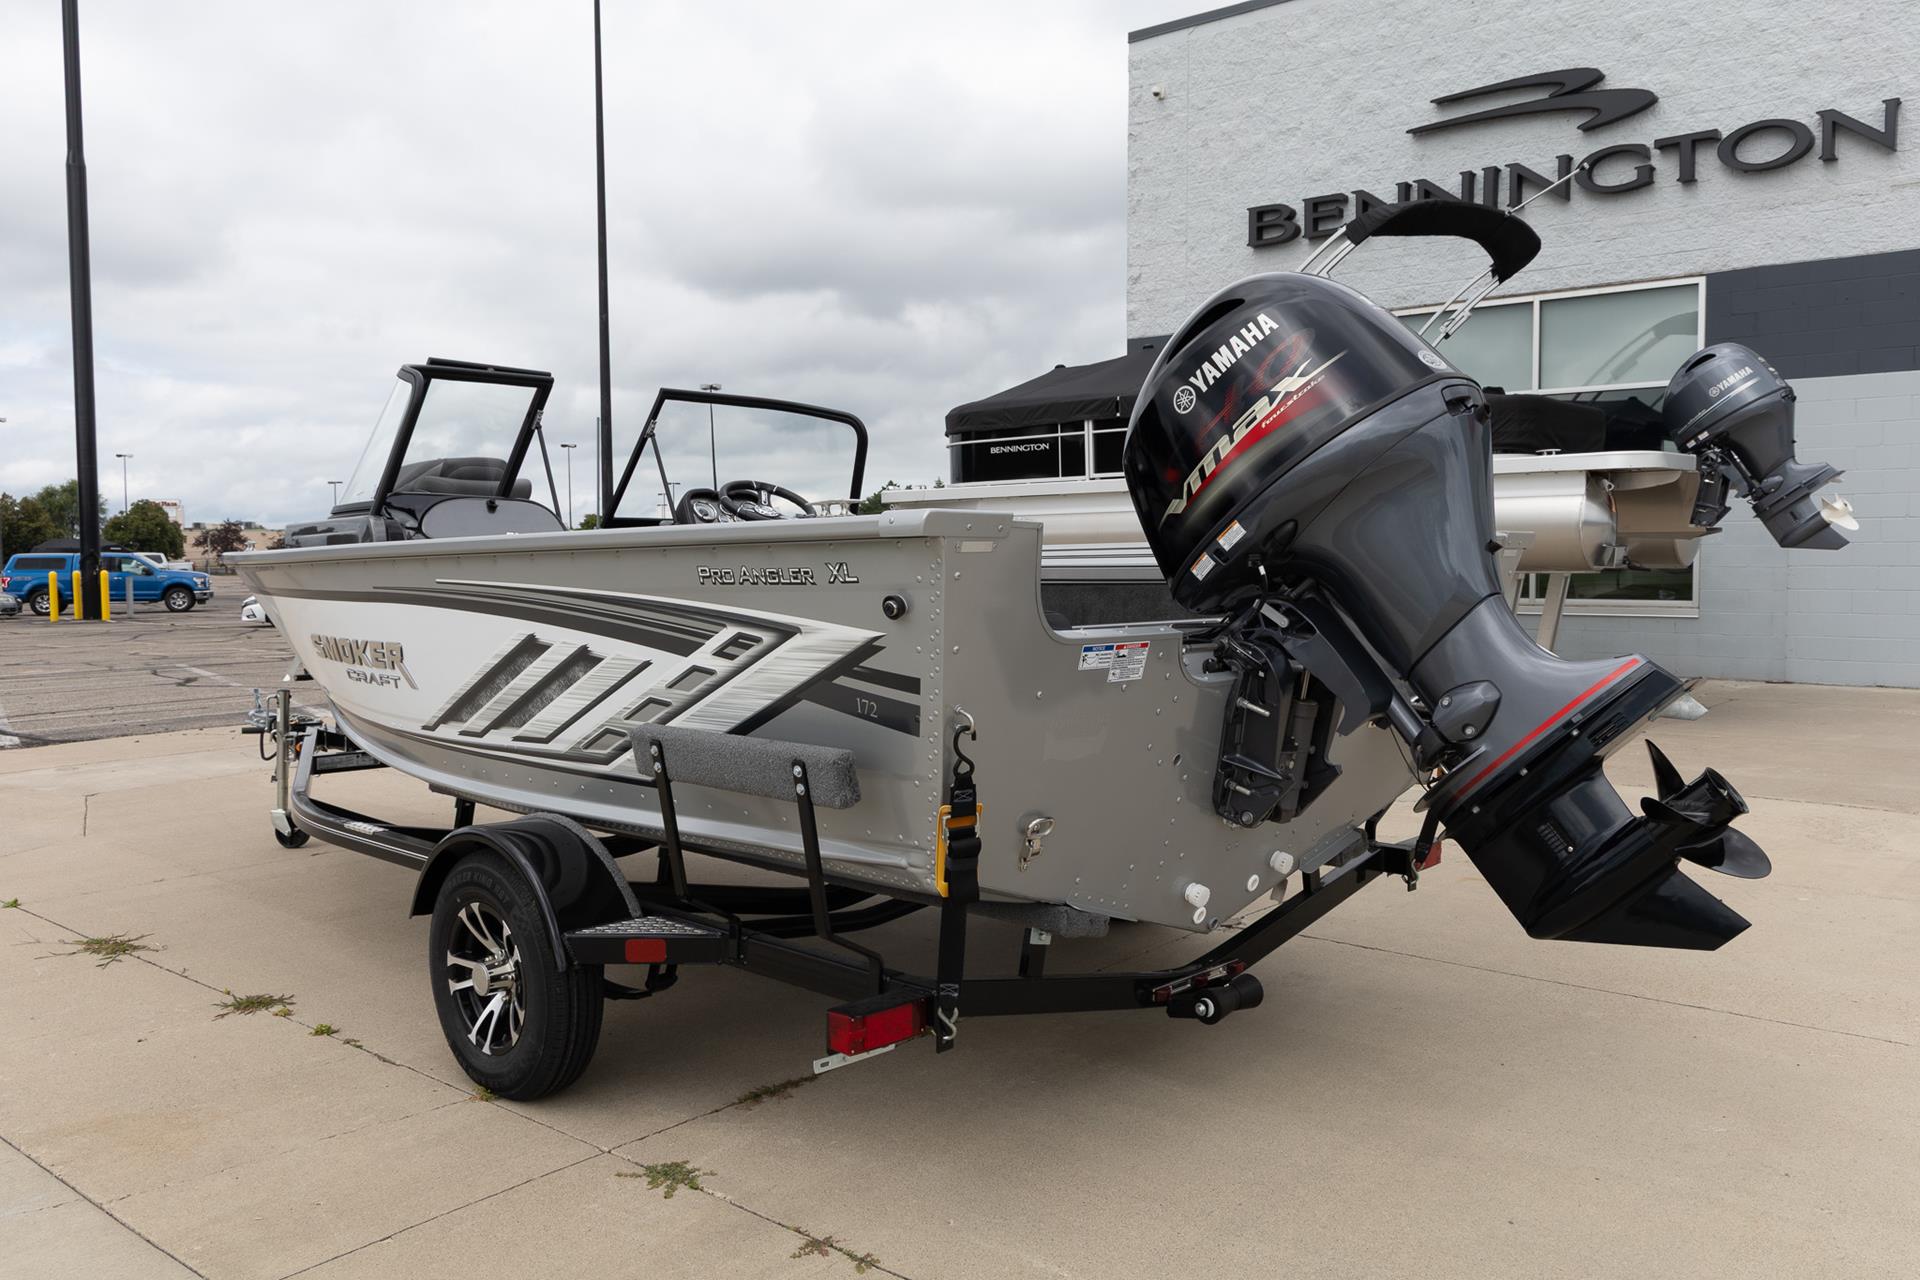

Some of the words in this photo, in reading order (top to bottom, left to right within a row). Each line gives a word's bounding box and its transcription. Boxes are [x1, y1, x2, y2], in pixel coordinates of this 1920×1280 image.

[1189, 313, 1280, 393] YAMAHA
[1716, 366, 1754, 391] YAMAHA
[990, 442, 1050, 454] BENNINGTON
[825, 562, 859, 584] XL
[311, 633, 419, 690] SMOKER
[346, 668, 401, 689] CRAFT
[856, 697, 878, 718] 172
